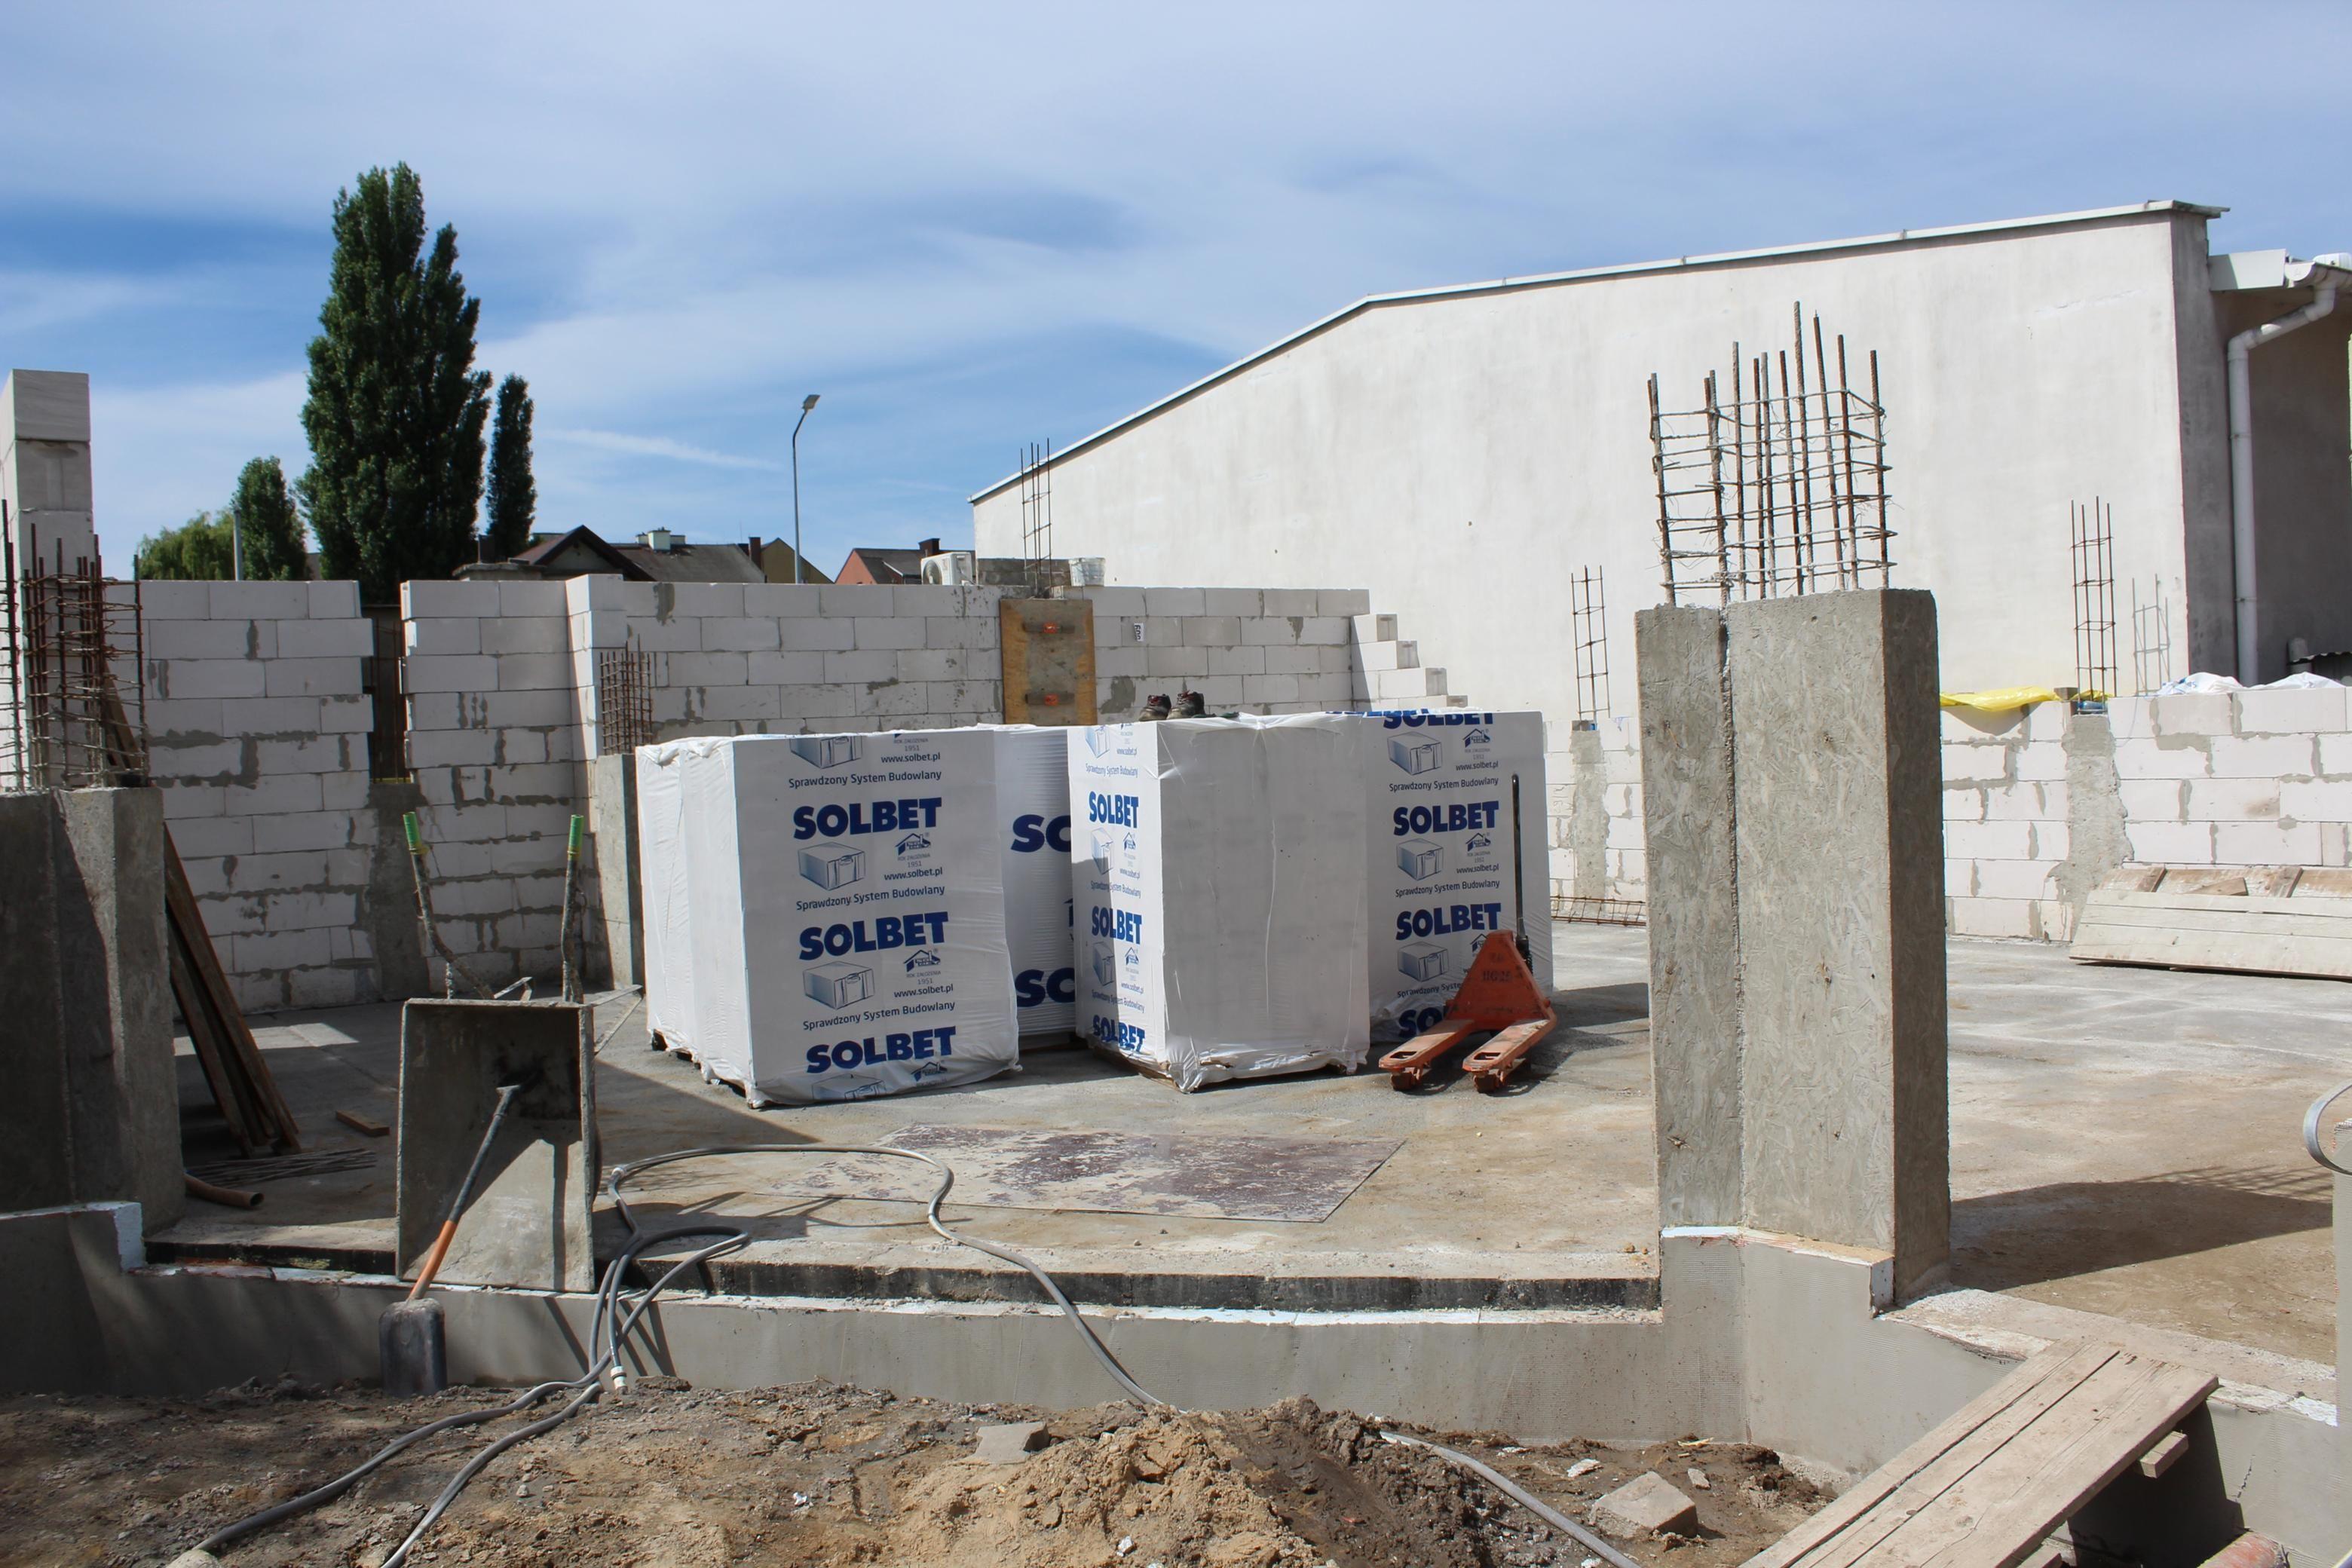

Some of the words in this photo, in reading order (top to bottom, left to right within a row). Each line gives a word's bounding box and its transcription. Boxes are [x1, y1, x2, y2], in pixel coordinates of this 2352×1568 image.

[881, 752, 941, 763] www.solbet.pl
[1456, 761, 1499, 770] www.solbet.pl
[789, 776, 848, 789] Sprawdzony
[851, 773, 886, 785] System
[889, 770, 942, 781] Budowlany
[1086, 763, 1106, 776] Sprawdzony
[1107, 766, 1119, 777] System
[1119, 766, 1138, 778] Budowlany
[1389, 781, 1432, 792] Sprawdzony
[1434, 778, 1459, 790] System
[1461, 776, 1499, 788] Budowlany
[793, 798, 942, 840] SOLBET
[1089, 791, 1139, 828] SOLBET
[1393, 801, 1499, 836] SOLBET
[884, 867, 942, 880] www.solbet.pl
[1456, 864, 1499, 874] www.solbet.pl
[796, 896, 851, 911] Sprawdzony
[853, 893, 889, 904] System
[893, 885, 945, 898] Budowlany
[1110, 882, 1122, 893] System
[1122, 884, 1141, 899] Budowlany
[1395, 887, 1432, 898] Sprawdzony
[1435, 884, 1460, 895] System
[1462, 880, 1500, 890] Budowlany
[1092, 905, 1142, 945] SOLBET
[1396, 902, 1501, 940] SOLBET
[799, 911, 948, 960] SOLBET
[894, 984, 953, 998] www.solbet.pl
[1397, 986, 1439, 998] Sprawdzony
[1441, 982, 1462, 992] Syste
[803, 1013, 861, 1031] Sprawdzony
[864, 1009, 900, 1021] System
[902, 1002, 955, 1015] Budowlany
[1398, 1007, 1447, 1038] SO
[1093, 1015, 1145, 1052] SOLBET
[806, 1026, 956, 1073] SOLBET
